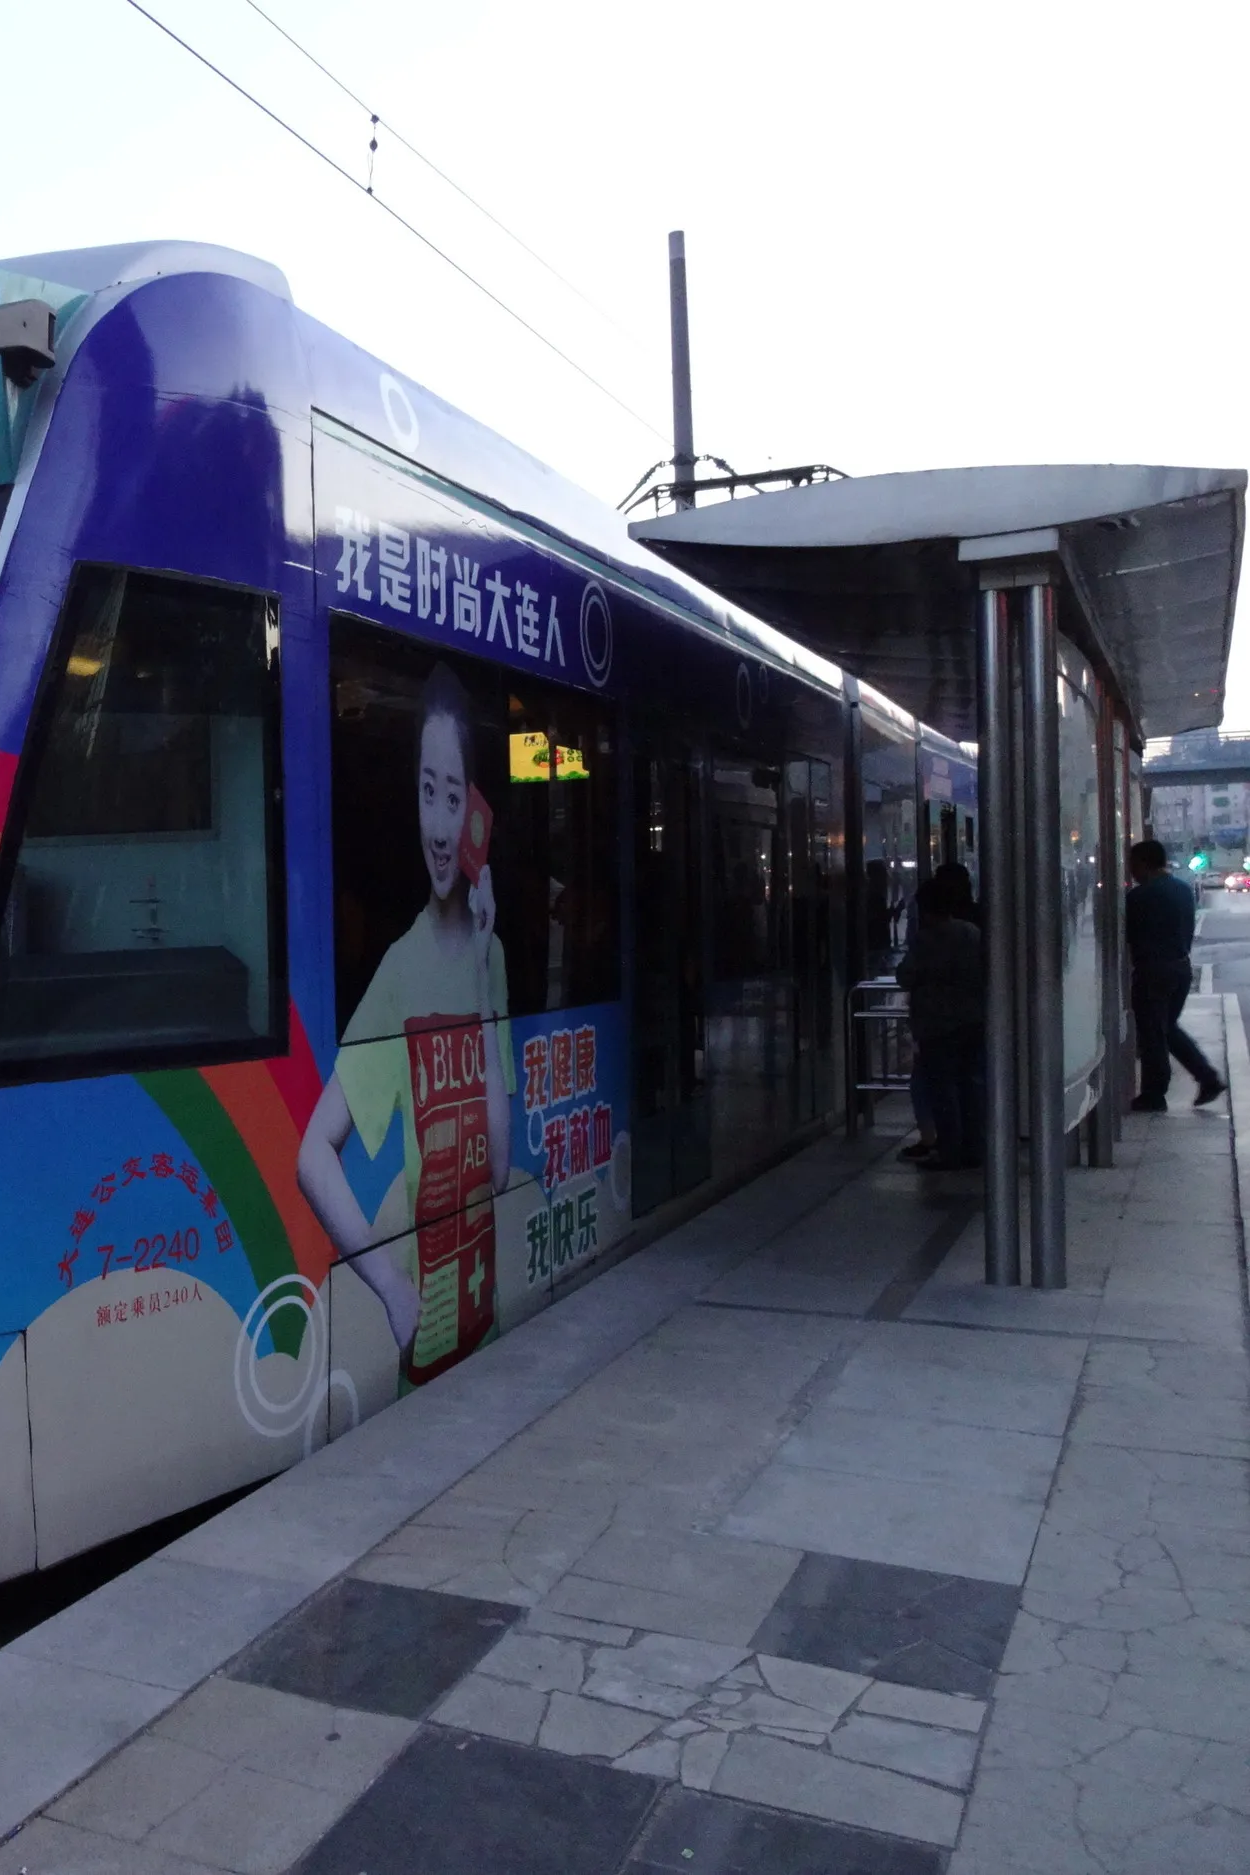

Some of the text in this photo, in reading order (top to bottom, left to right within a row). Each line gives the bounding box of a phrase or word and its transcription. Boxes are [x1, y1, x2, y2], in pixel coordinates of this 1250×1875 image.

[335, 506, 566, 667] 我是时尚大连人
[524, 1025, 596, 1109] 我健康
[462, 1134, 488, 1175] AB
[544, 1101, 613, 1190] 我献血
[97, 1227, 201, 1280] 7-2240
[526, 1190, 597, 1284] 我快乐
[96, 1281, 203, 1328] 额定乘员240人
